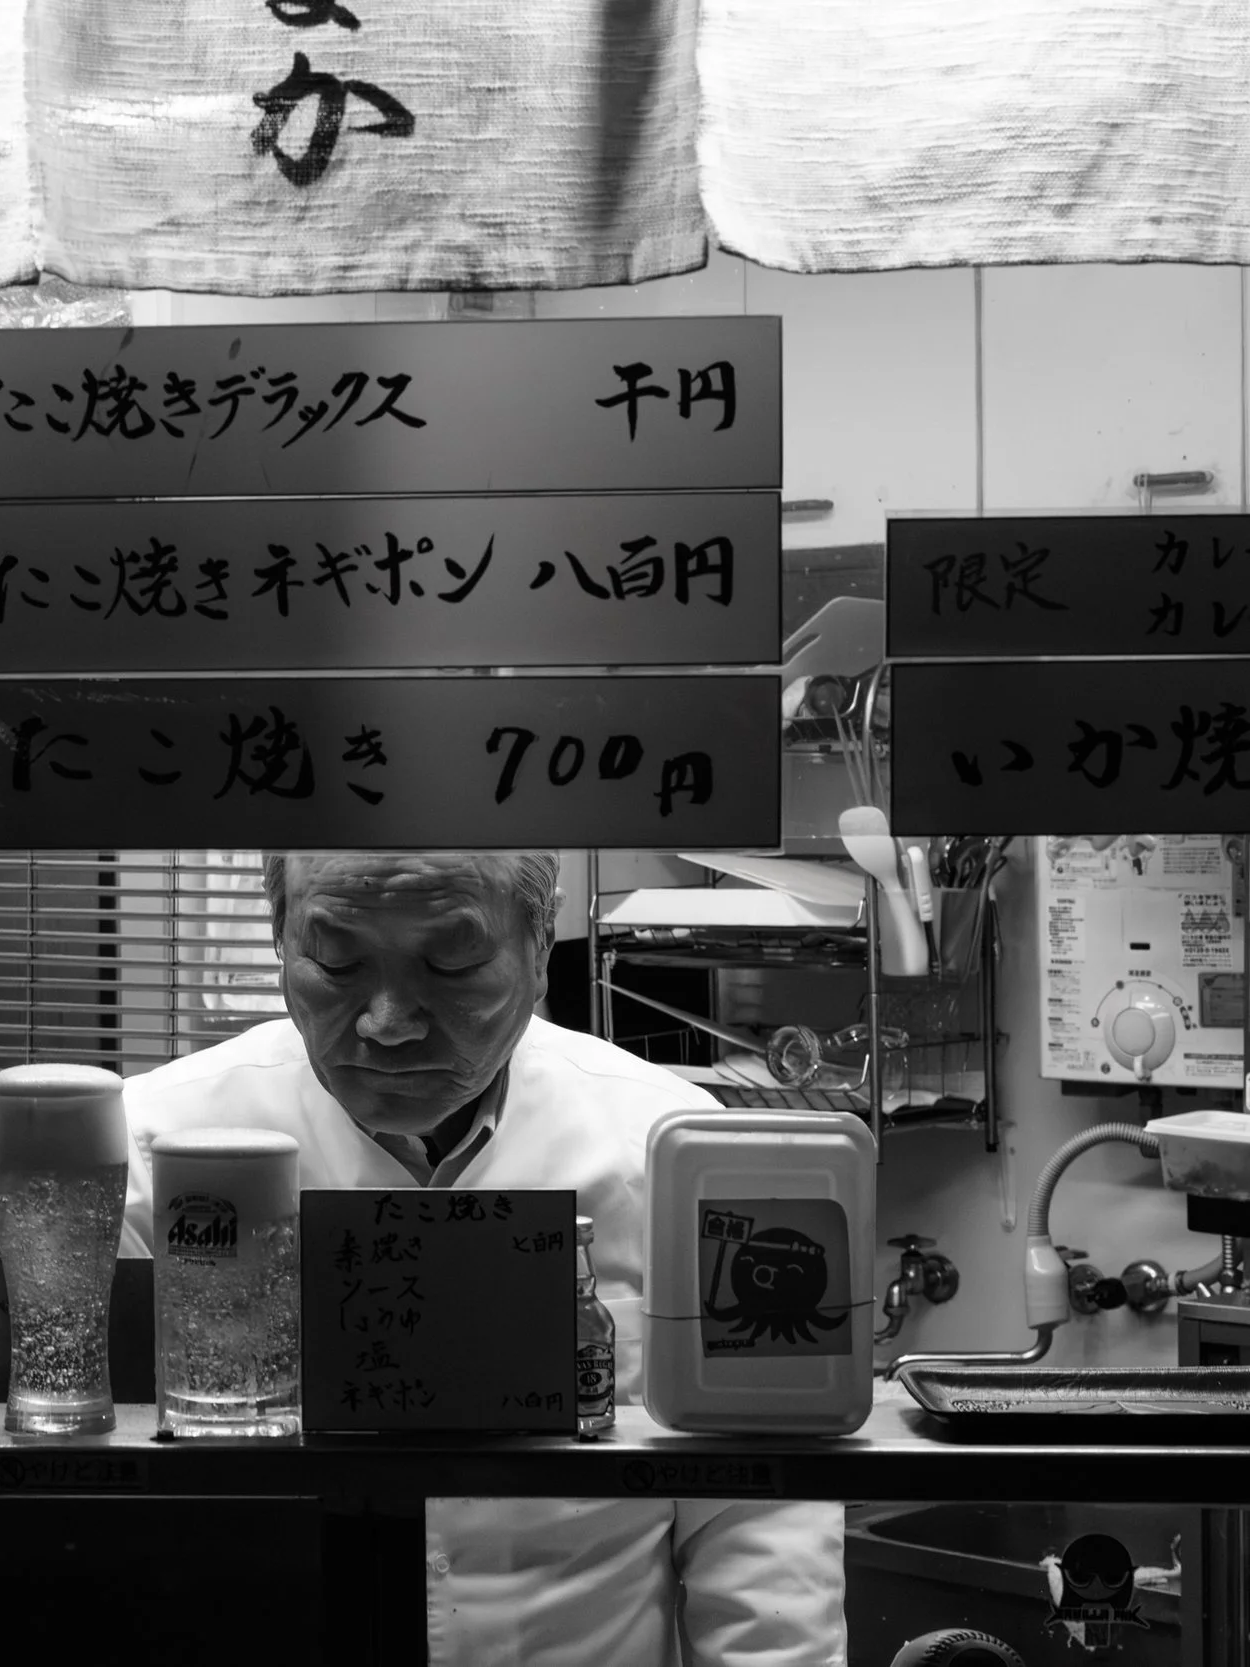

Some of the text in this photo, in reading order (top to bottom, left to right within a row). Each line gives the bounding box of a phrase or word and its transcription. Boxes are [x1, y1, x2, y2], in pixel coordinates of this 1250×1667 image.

[250, 0, 416, 188] か
[595, 360, 737, 443] 千円
[529, 535, 734, 607] 八百円
[1150, 529, 1250, 576] カレ
[922, 541, 1071, 617] 限定
[12, 706, 389, 807] たこ焼き
[951, 702, 1250, 797] いか焼
[167, 1213, 238, 1248] Asahi
[374, 1193, 514, 1226] たこ焼き
[339, 1275, 426, 1306] ソース
[339, 1305, 422, 1337] しょうゆ
[355, 1340, 401, 1372] 塩
[340, 1378, 436, 1413] ネギポン
